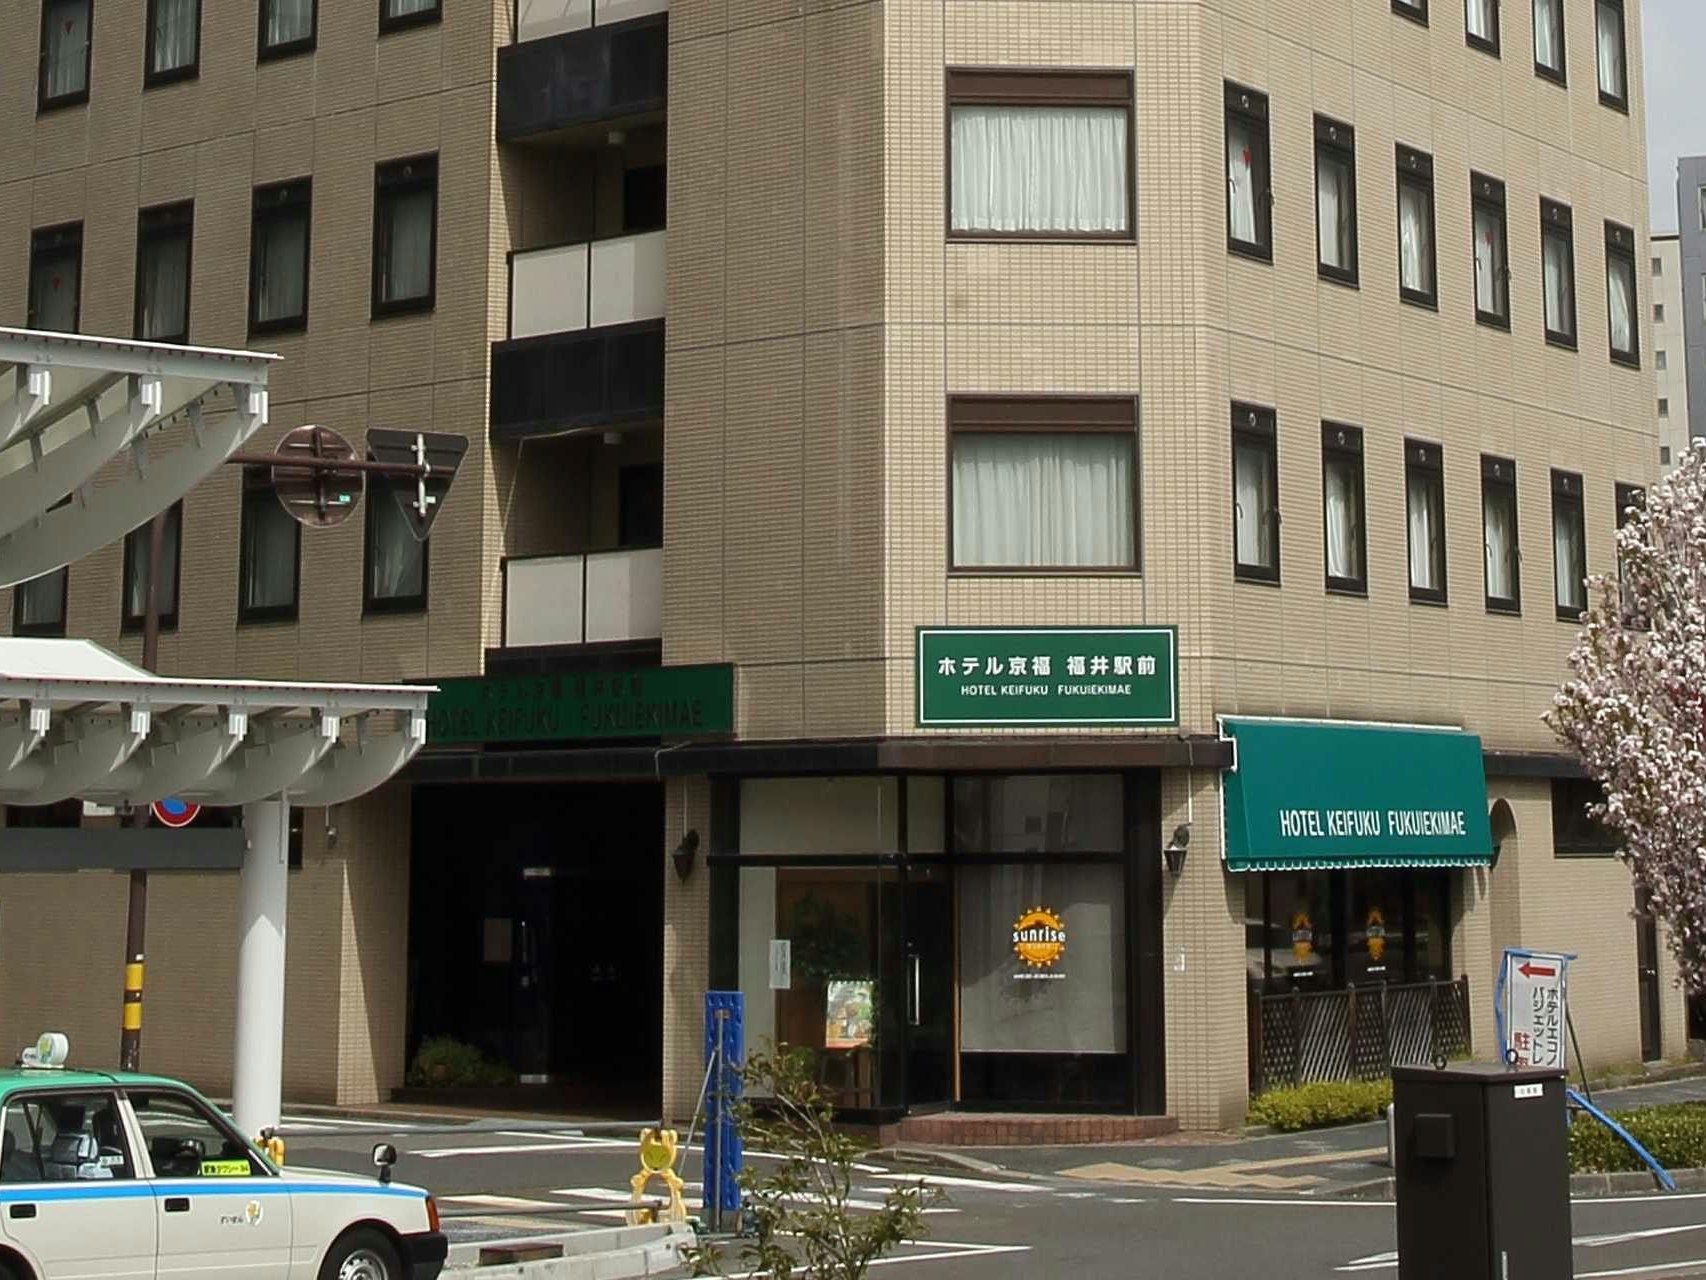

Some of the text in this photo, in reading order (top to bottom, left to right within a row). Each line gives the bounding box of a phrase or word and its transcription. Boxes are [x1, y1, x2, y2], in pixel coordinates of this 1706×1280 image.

[938, 655, 1157, 676] ホテル京福 福井駅前
[961, 683, 1131, 696] HOTEL KEIFUKU FUKUIEKIMAE
[1280, 809, 1466, 837] HOTEL KEIFUKU FUKUIEKIMAE
[1013, 925, 1066, 942] sunrise
[1546, 988, 1559, 1066] ホテルエコノ
